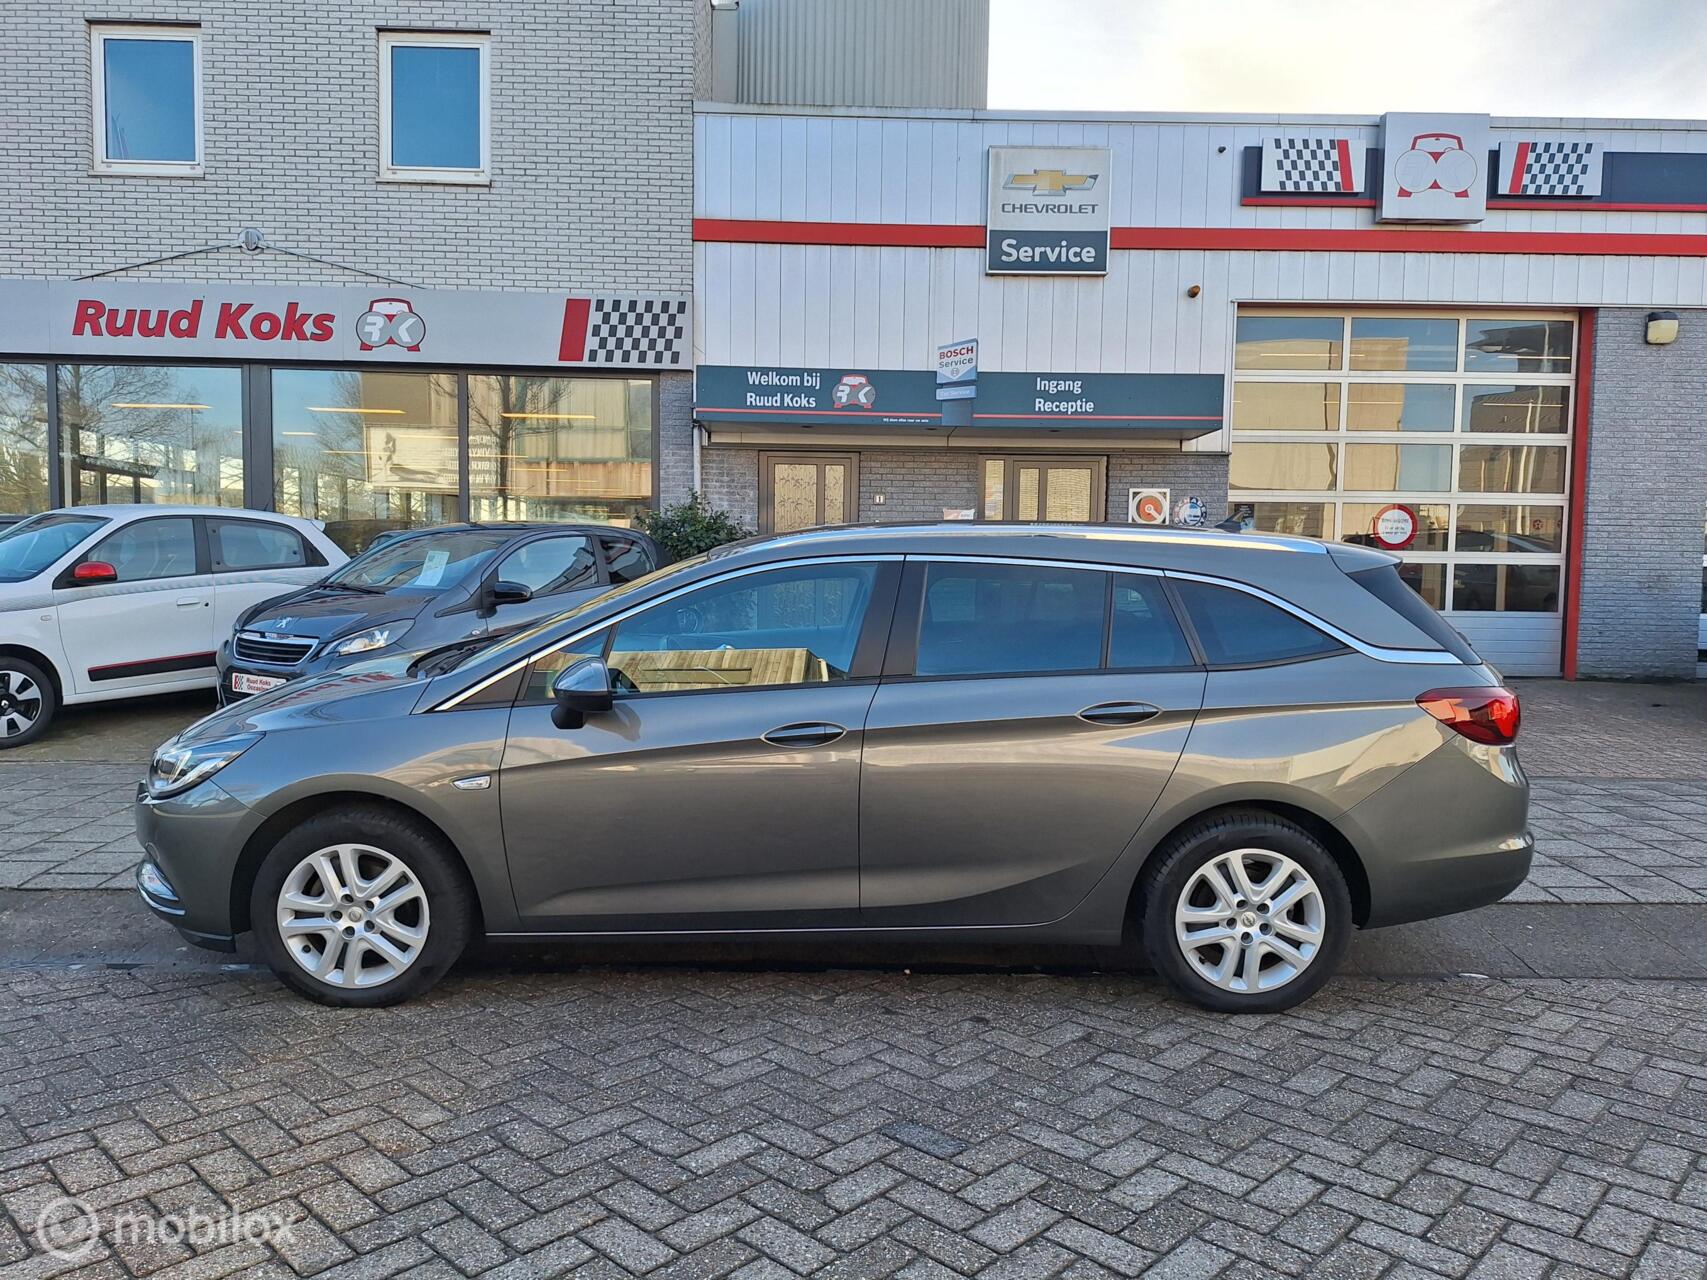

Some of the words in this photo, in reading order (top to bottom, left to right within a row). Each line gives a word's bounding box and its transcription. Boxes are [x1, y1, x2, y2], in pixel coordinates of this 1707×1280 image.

[1001, 203, 1099, 214] CHEVROLET
[1001, 238, 1096, 262] Service
[72, 299, 203, 338] Ruud
[215, 301, 336, 342] Koks
[939, 345, 974, 360] BOSCH
[938, 357, 974, 369] Service
[747, 371, 801, 386] Welkom
[803, 372, 821, 390] bij
[1036, 377, 1082, 394] Ingang
[746, 392, 781, 407] Ruud
[783, 393, 817, 408] Koks
[1035, 398, 1095, 415] Receptie
